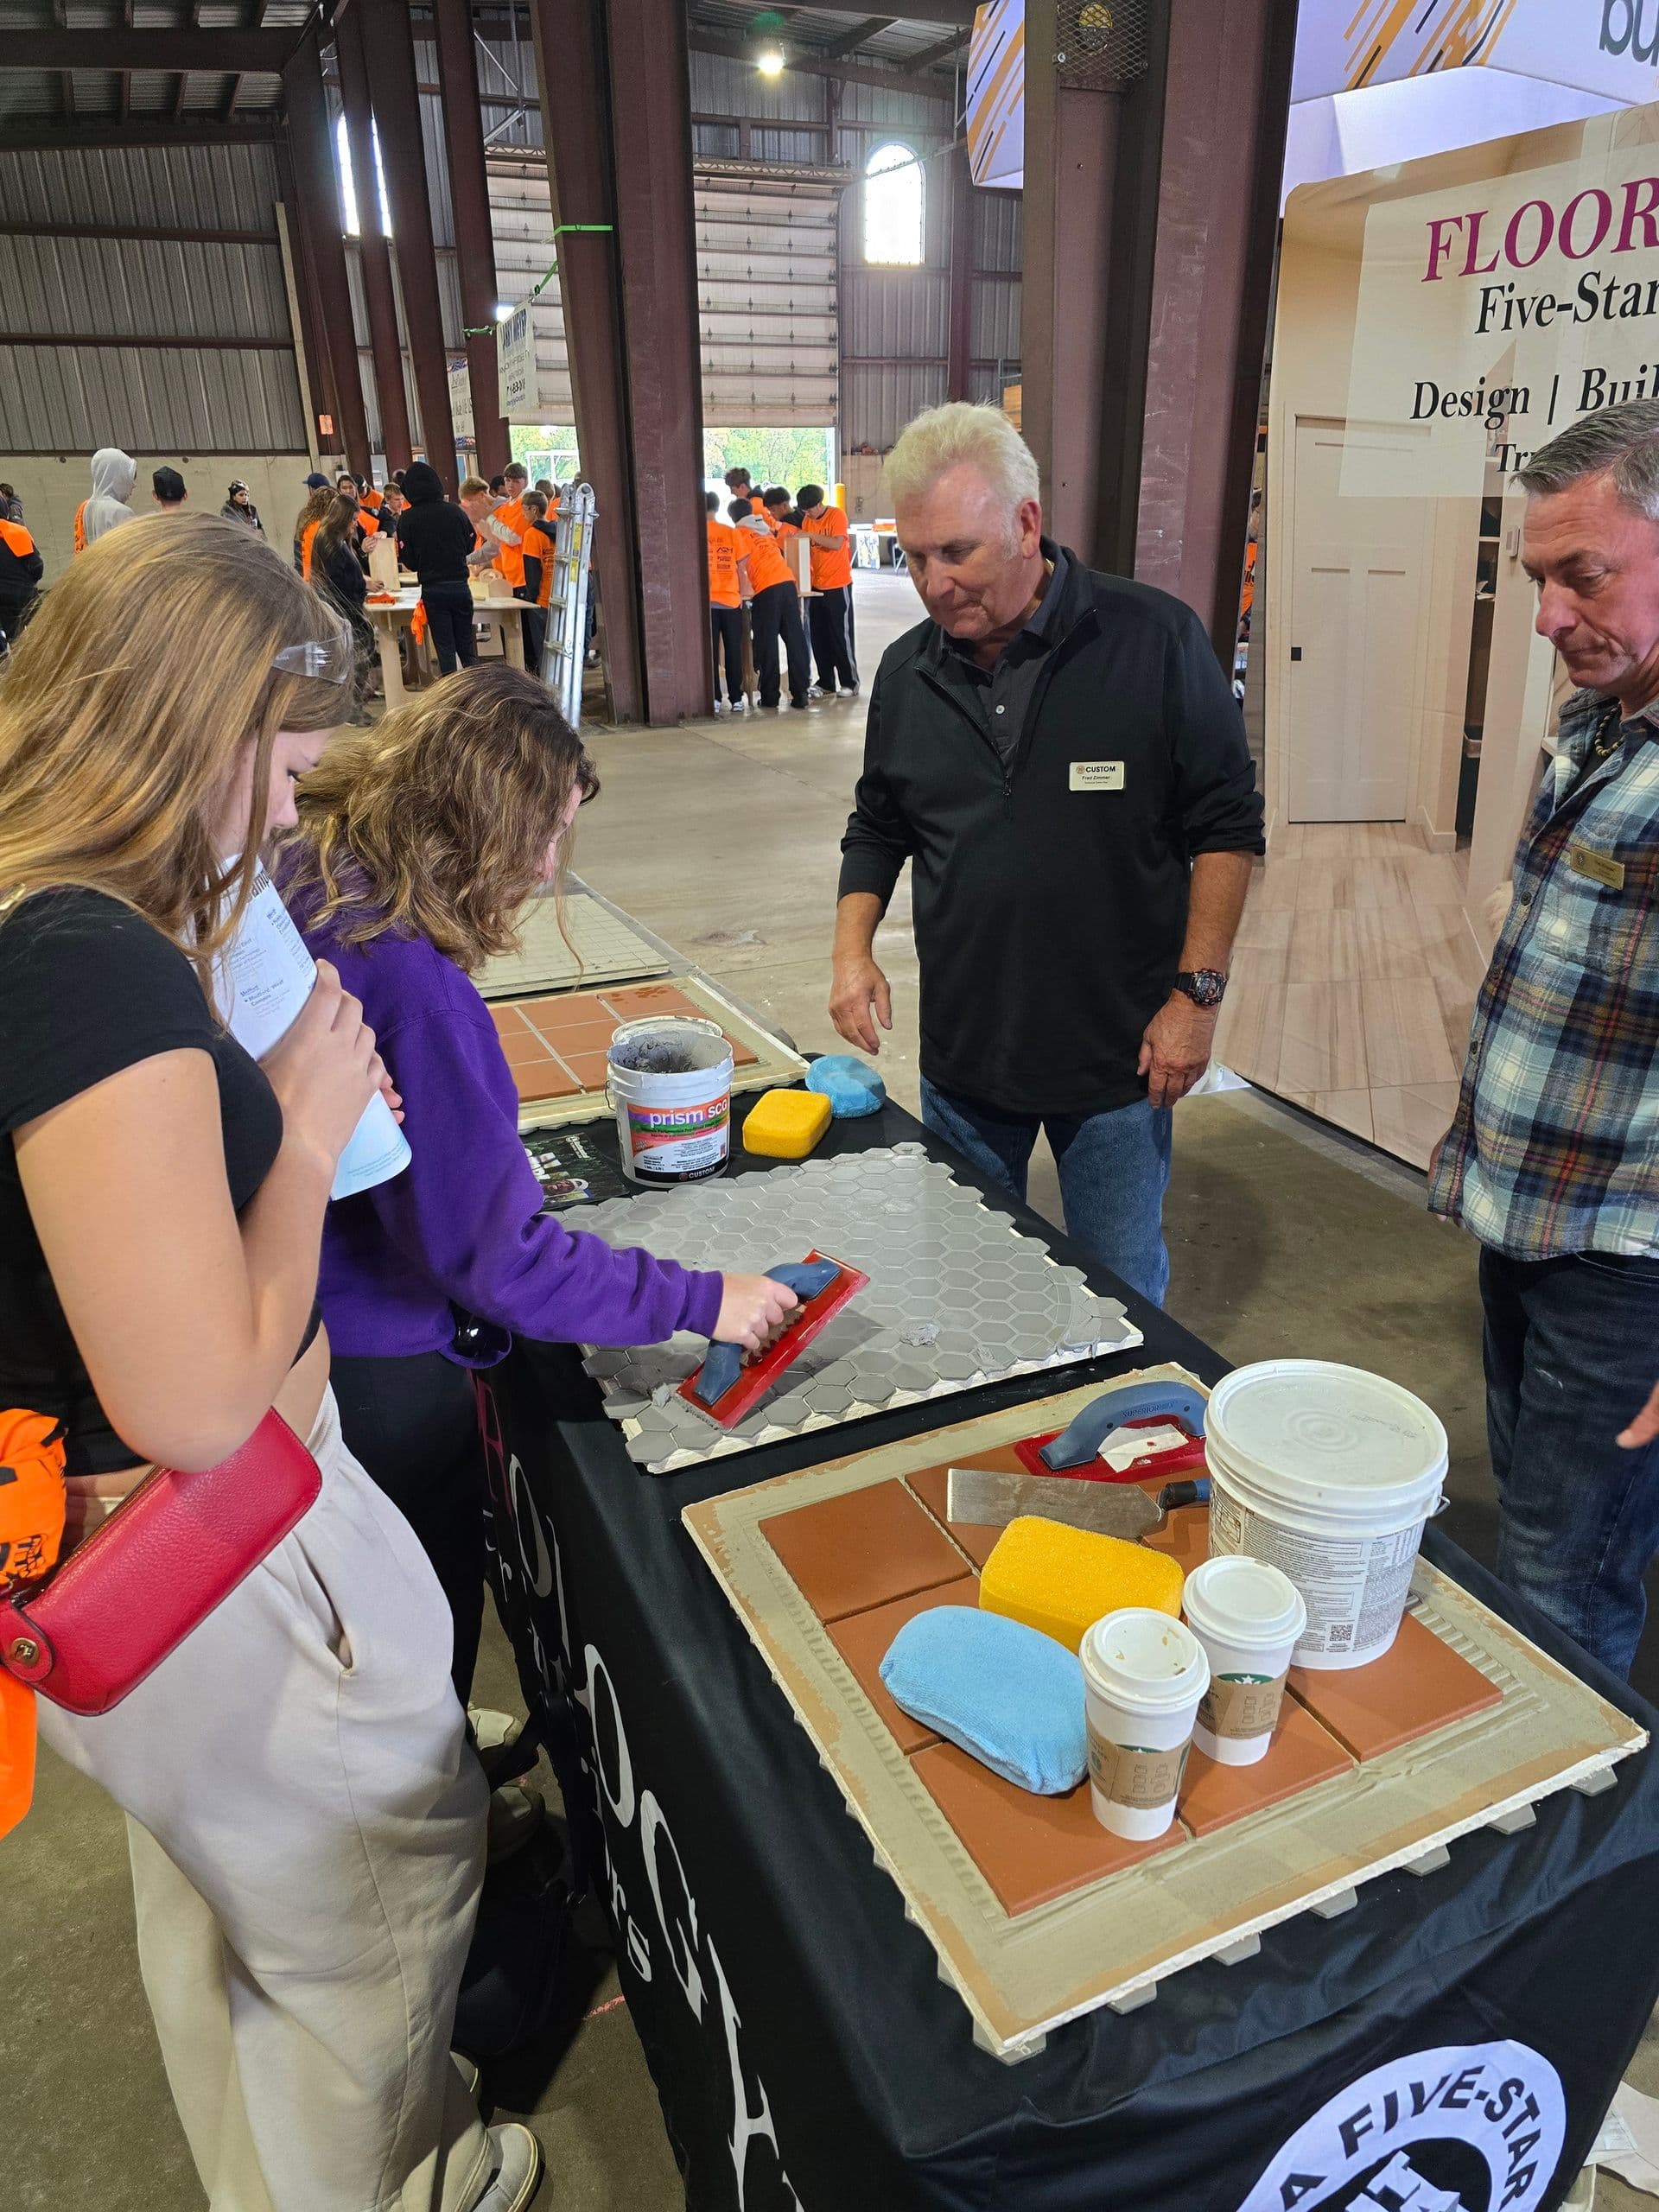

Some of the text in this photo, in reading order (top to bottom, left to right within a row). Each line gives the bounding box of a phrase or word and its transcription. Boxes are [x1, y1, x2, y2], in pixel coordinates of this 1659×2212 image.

[1410, 375, 1530, 430] Design
[650, 1110, 703, 1128] prism
[708, 1099, 728, 1119] SCG
[689, 1166, 715, 1179] CUSTOM
[1281, 2065, 1541, 2212] A FIVE-STAR
